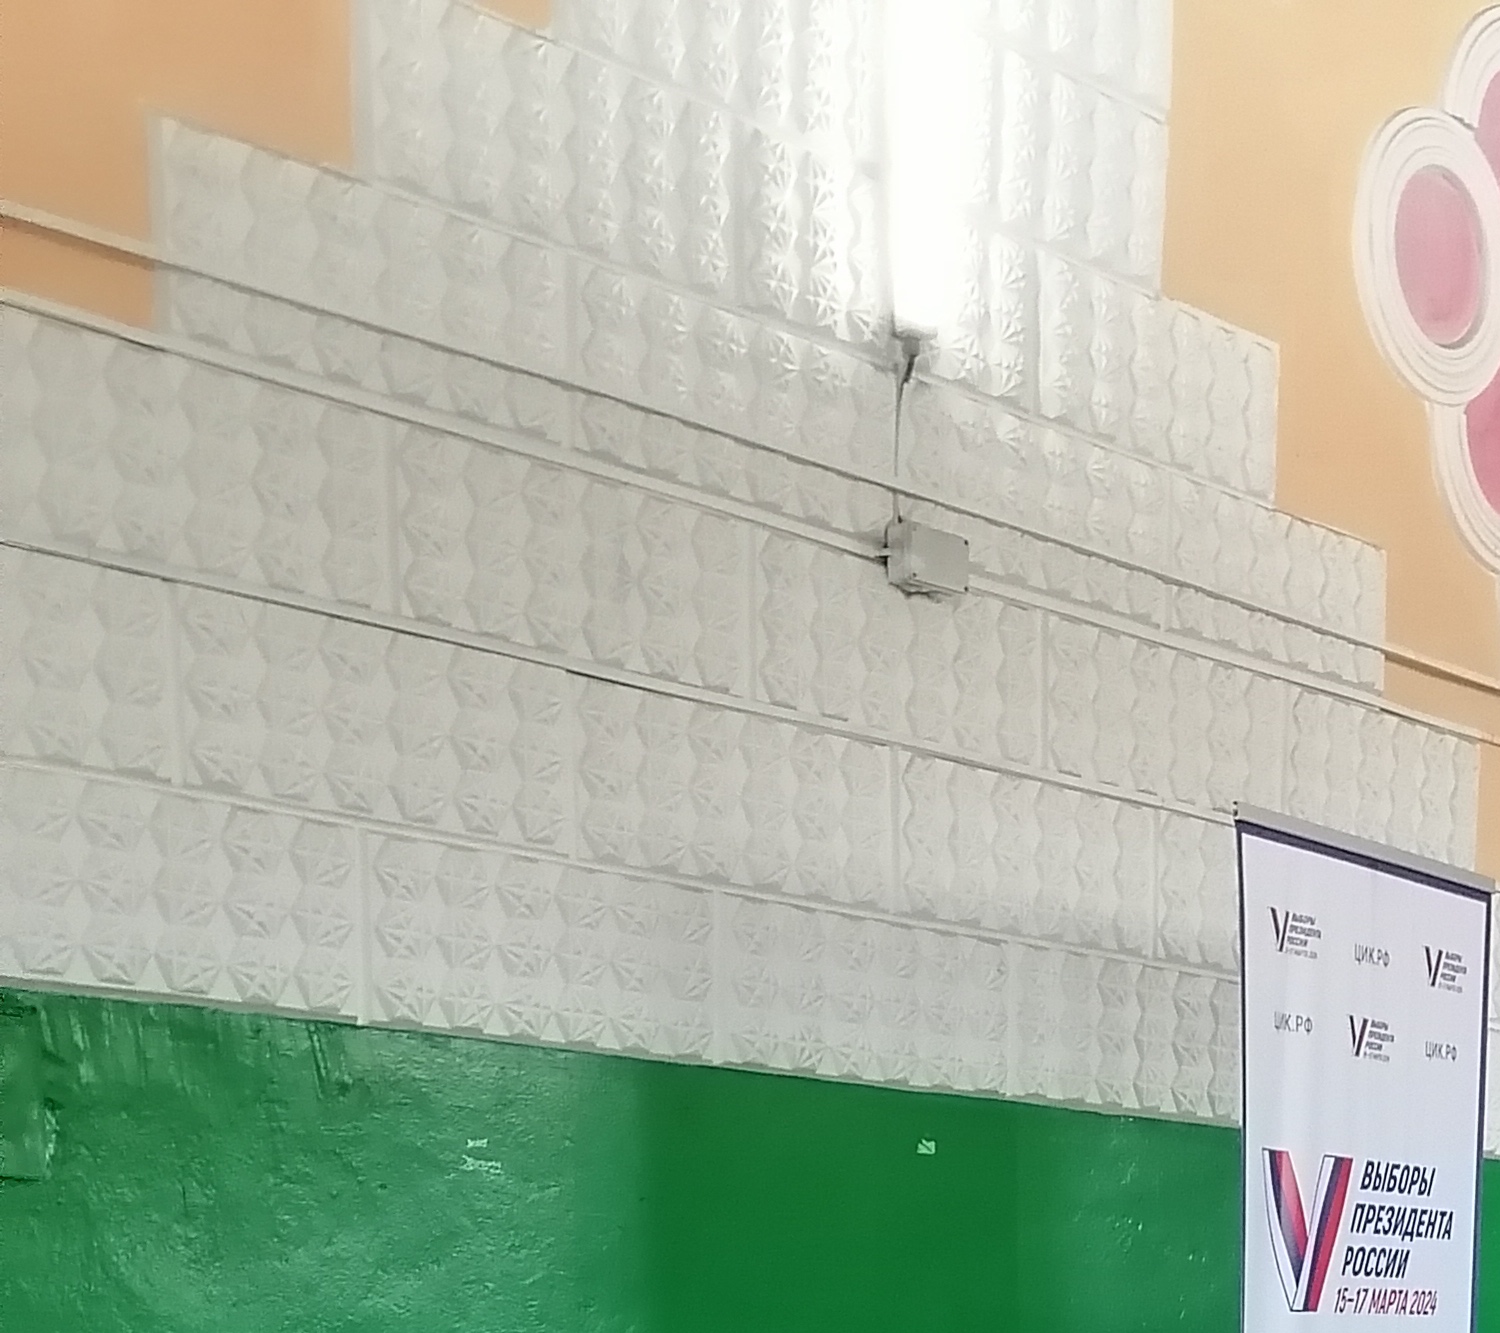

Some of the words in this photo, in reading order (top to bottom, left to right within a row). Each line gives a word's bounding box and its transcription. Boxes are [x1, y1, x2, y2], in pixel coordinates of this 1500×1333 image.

[1354, 943, 1391, 968] ЦИК.РФ
[1425, 1041, 1458, 1062] ЦИК.РФ
[1360, 1159, 1436, 1197] ВЫБОРЫ
[1350, 1202, 1454, 1242] ПРЕЗИДЕНТА
[1341, 1245, 1411, 1279] РОССИИ
[1368, 1288, 1408, 1315] МАРТА
[1409, 1290, 1438, 1316] 2024
